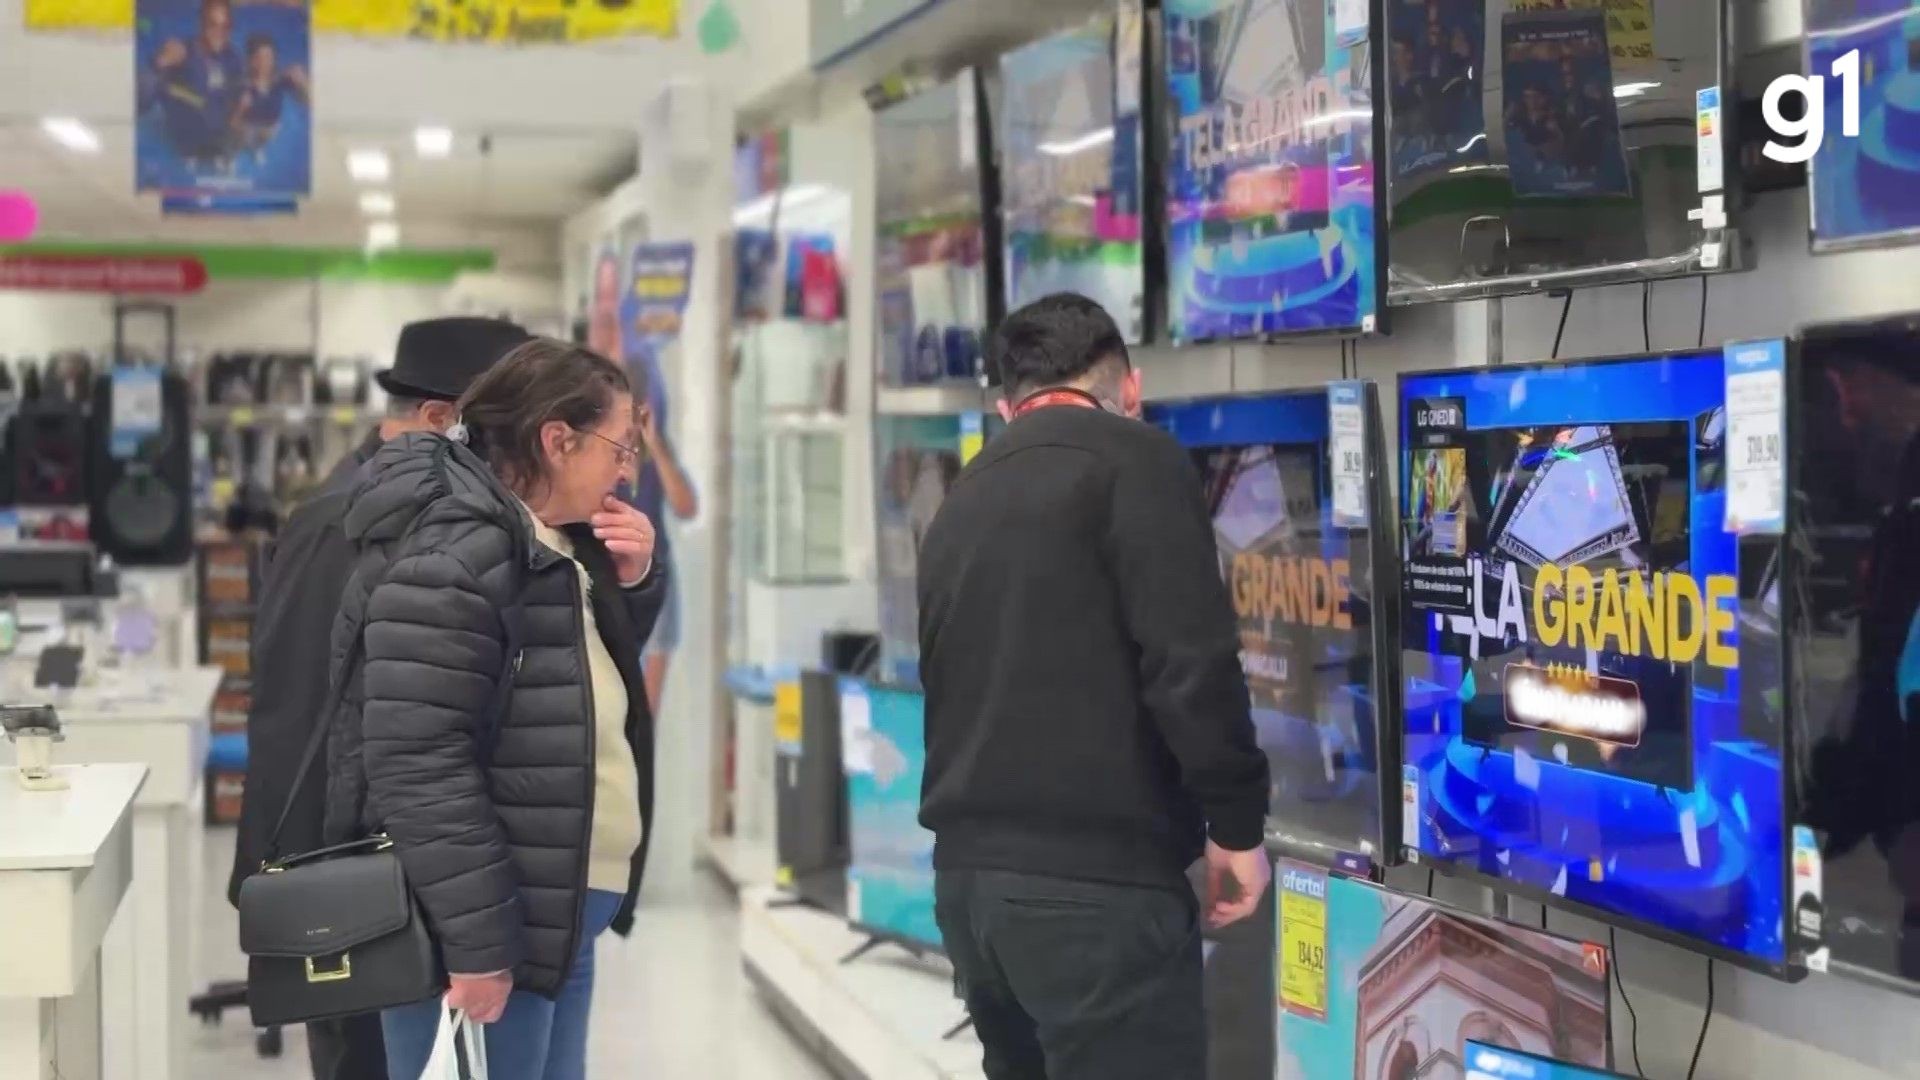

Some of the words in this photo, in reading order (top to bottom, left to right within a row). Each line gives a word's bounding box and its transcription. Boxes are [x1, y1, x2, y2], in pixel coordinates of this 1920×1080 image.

[1231, 551, 1352, 630] GRANDE
[1533, 562, 1739, 668] GRANDE
[1282, 870, 1325, 898] oferta!
